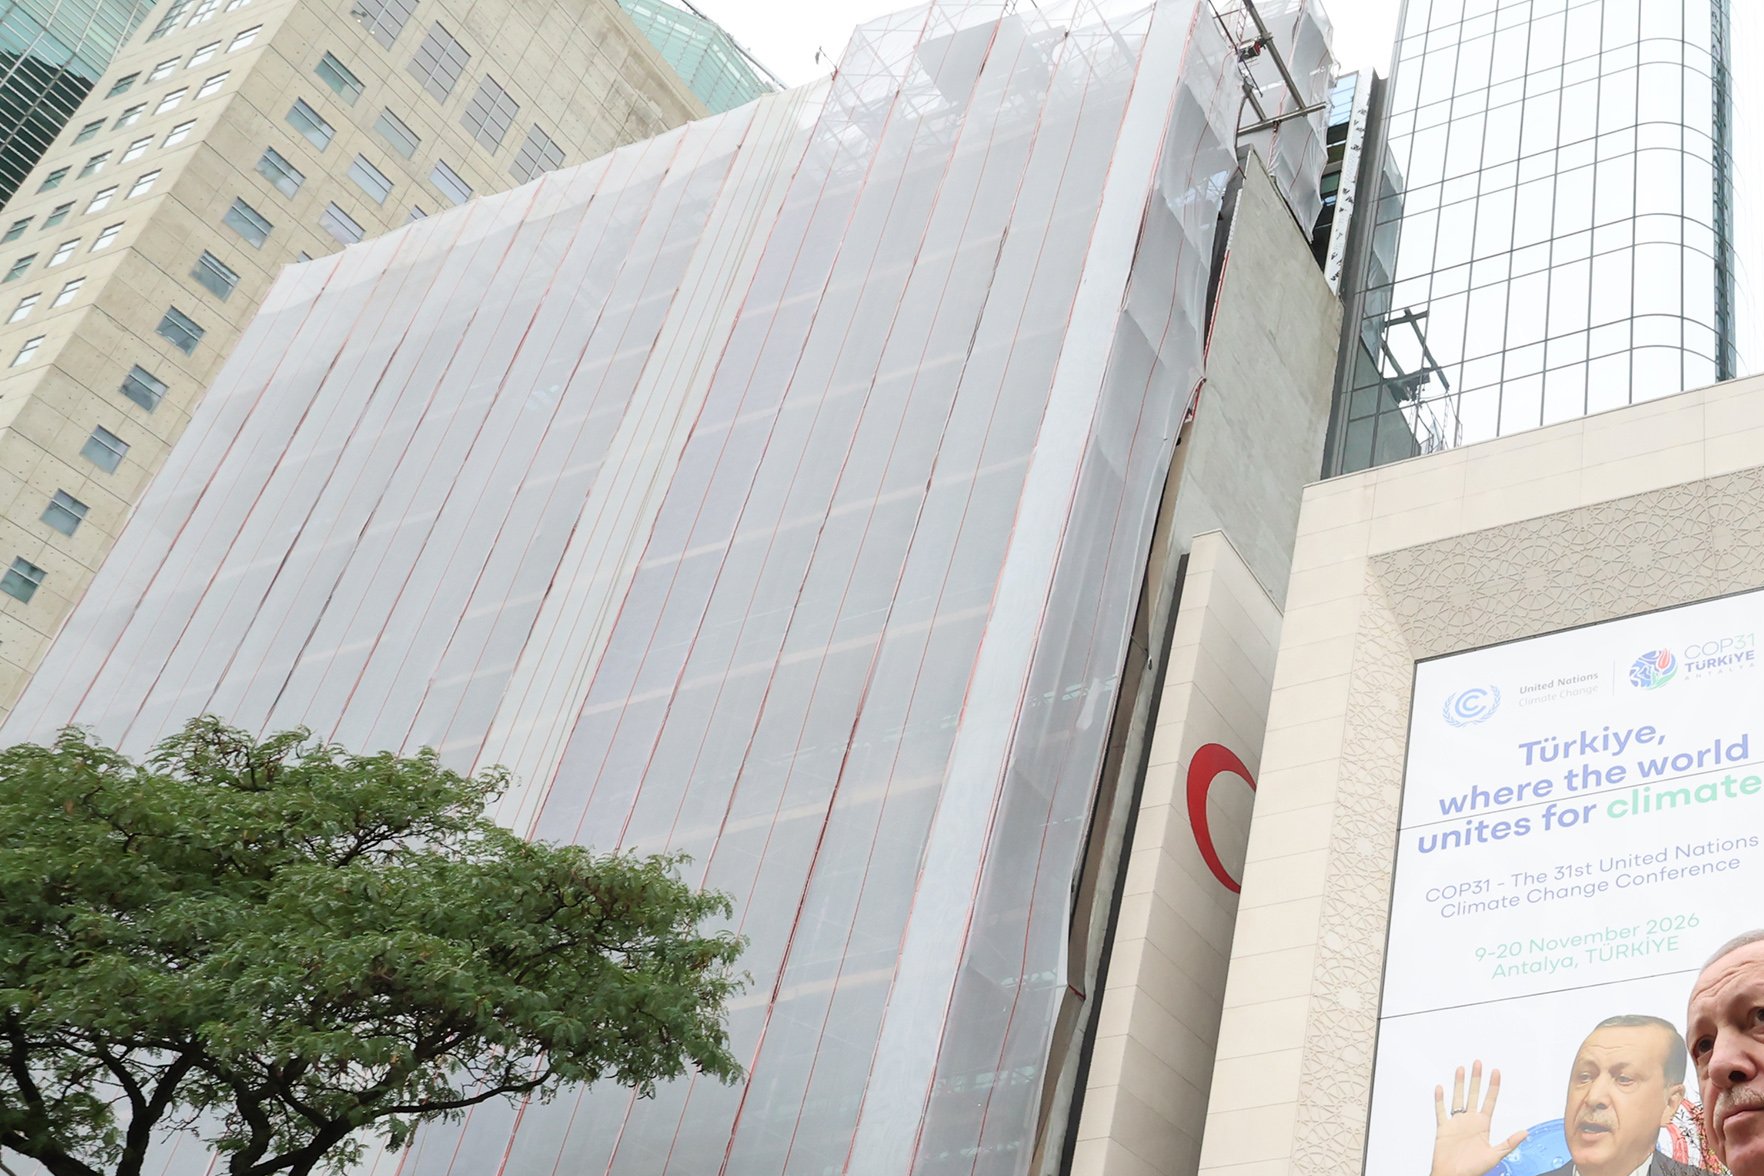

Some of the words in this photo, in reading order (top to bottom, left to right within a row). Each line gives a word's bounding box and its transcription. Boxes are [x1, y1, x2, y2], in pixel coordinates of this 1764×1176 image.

[1684, 633, 1755, 659] COP31
[1518, 692, 1557, 708] Climate
[1559, 684, 1599, 701] Change
[1519, 679, 1555, 695] United
[1557, 671, 1599, 685] Nations
[1518, 724, 1666, 767] Türkiye,
[1438, 775, 1554, 816] where
[1563, 763, 1627, 792] the
[1637, 733, 1750, 779] world
[1417, 816, 1532, 854] unites
[1543, 802, 1598, 831] for
[1425, 879, 1491, 903] COP31
[1510, 870, 1548, 889] The
[1553, 862, 1593, 880] 31st
[1600, 847, 1669, 873] United
[1675, 834, 1760, 861] Nations
[1440, 894, 1520, 919] Climate
[1526, 879, 1610, 904] Change
[1615, 856, 1741, 890] Conference
[1474, 940, 1523, 963] 9-20
[1529, 924, 1641, 954] November
[1646, 912, 1701, 937] 2026
[1491, 954, 1579, 980] Antalya,
[1584, 935, 1680, 965] TÜRKİYE
